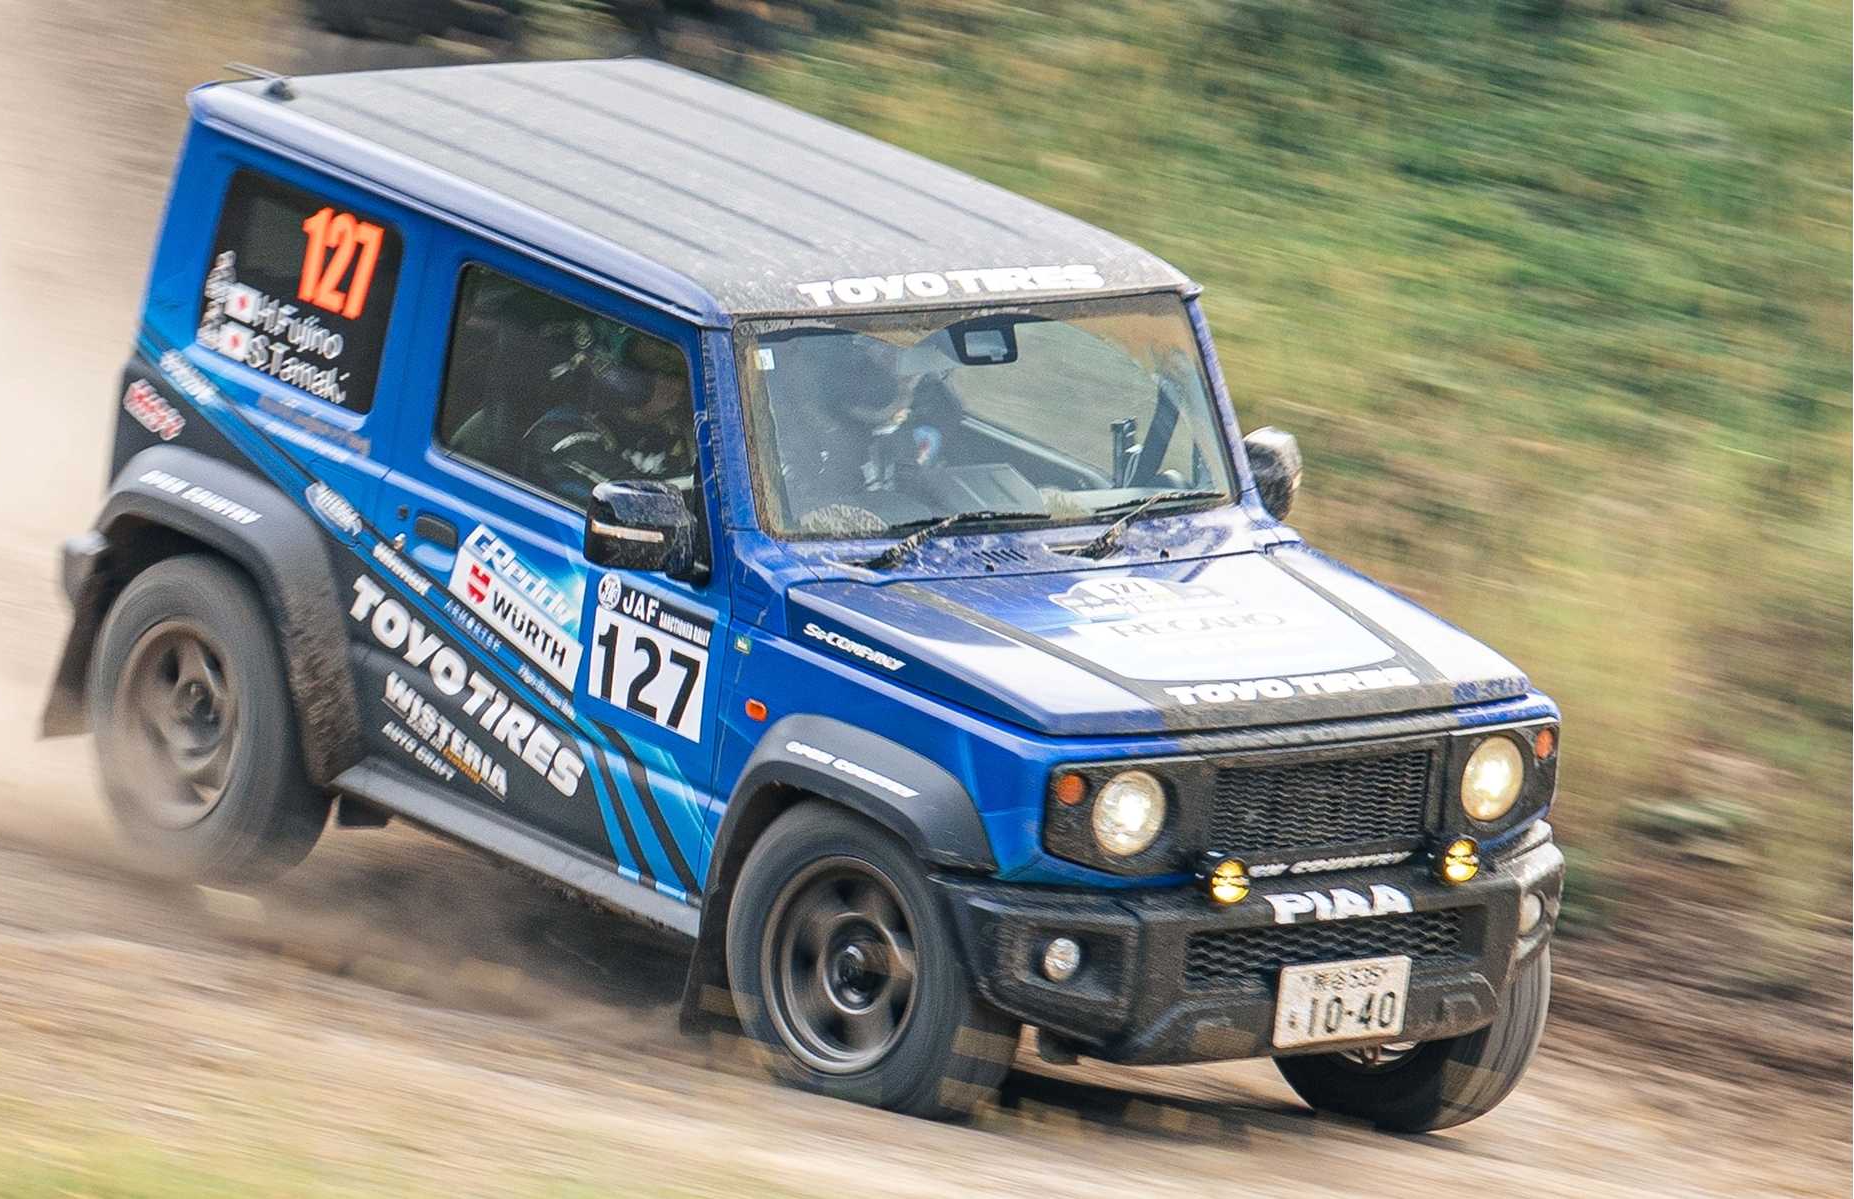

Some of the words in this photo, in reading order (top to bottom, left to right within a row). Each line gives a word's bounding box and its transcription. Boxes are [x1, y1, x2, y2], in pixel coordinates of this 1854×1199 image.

[298, 207, 385, 320] 127
[796, 272, 949, 307] TOYO
[946, 264, 1105, 294] TIRES
[622, 591, 659, 623] JAF
[349, 574, 468, 696] TOYO
[462, 671, 586, 797] TIRES
[597, 623, 701, 730] 127
[1164, 678, 1298, 705] TOYO
[1293, 666, 1420, 696] TIRES
[385, 671, 508, 797] WISTERIA
[1262, 884, 1414, 925] PIAA
